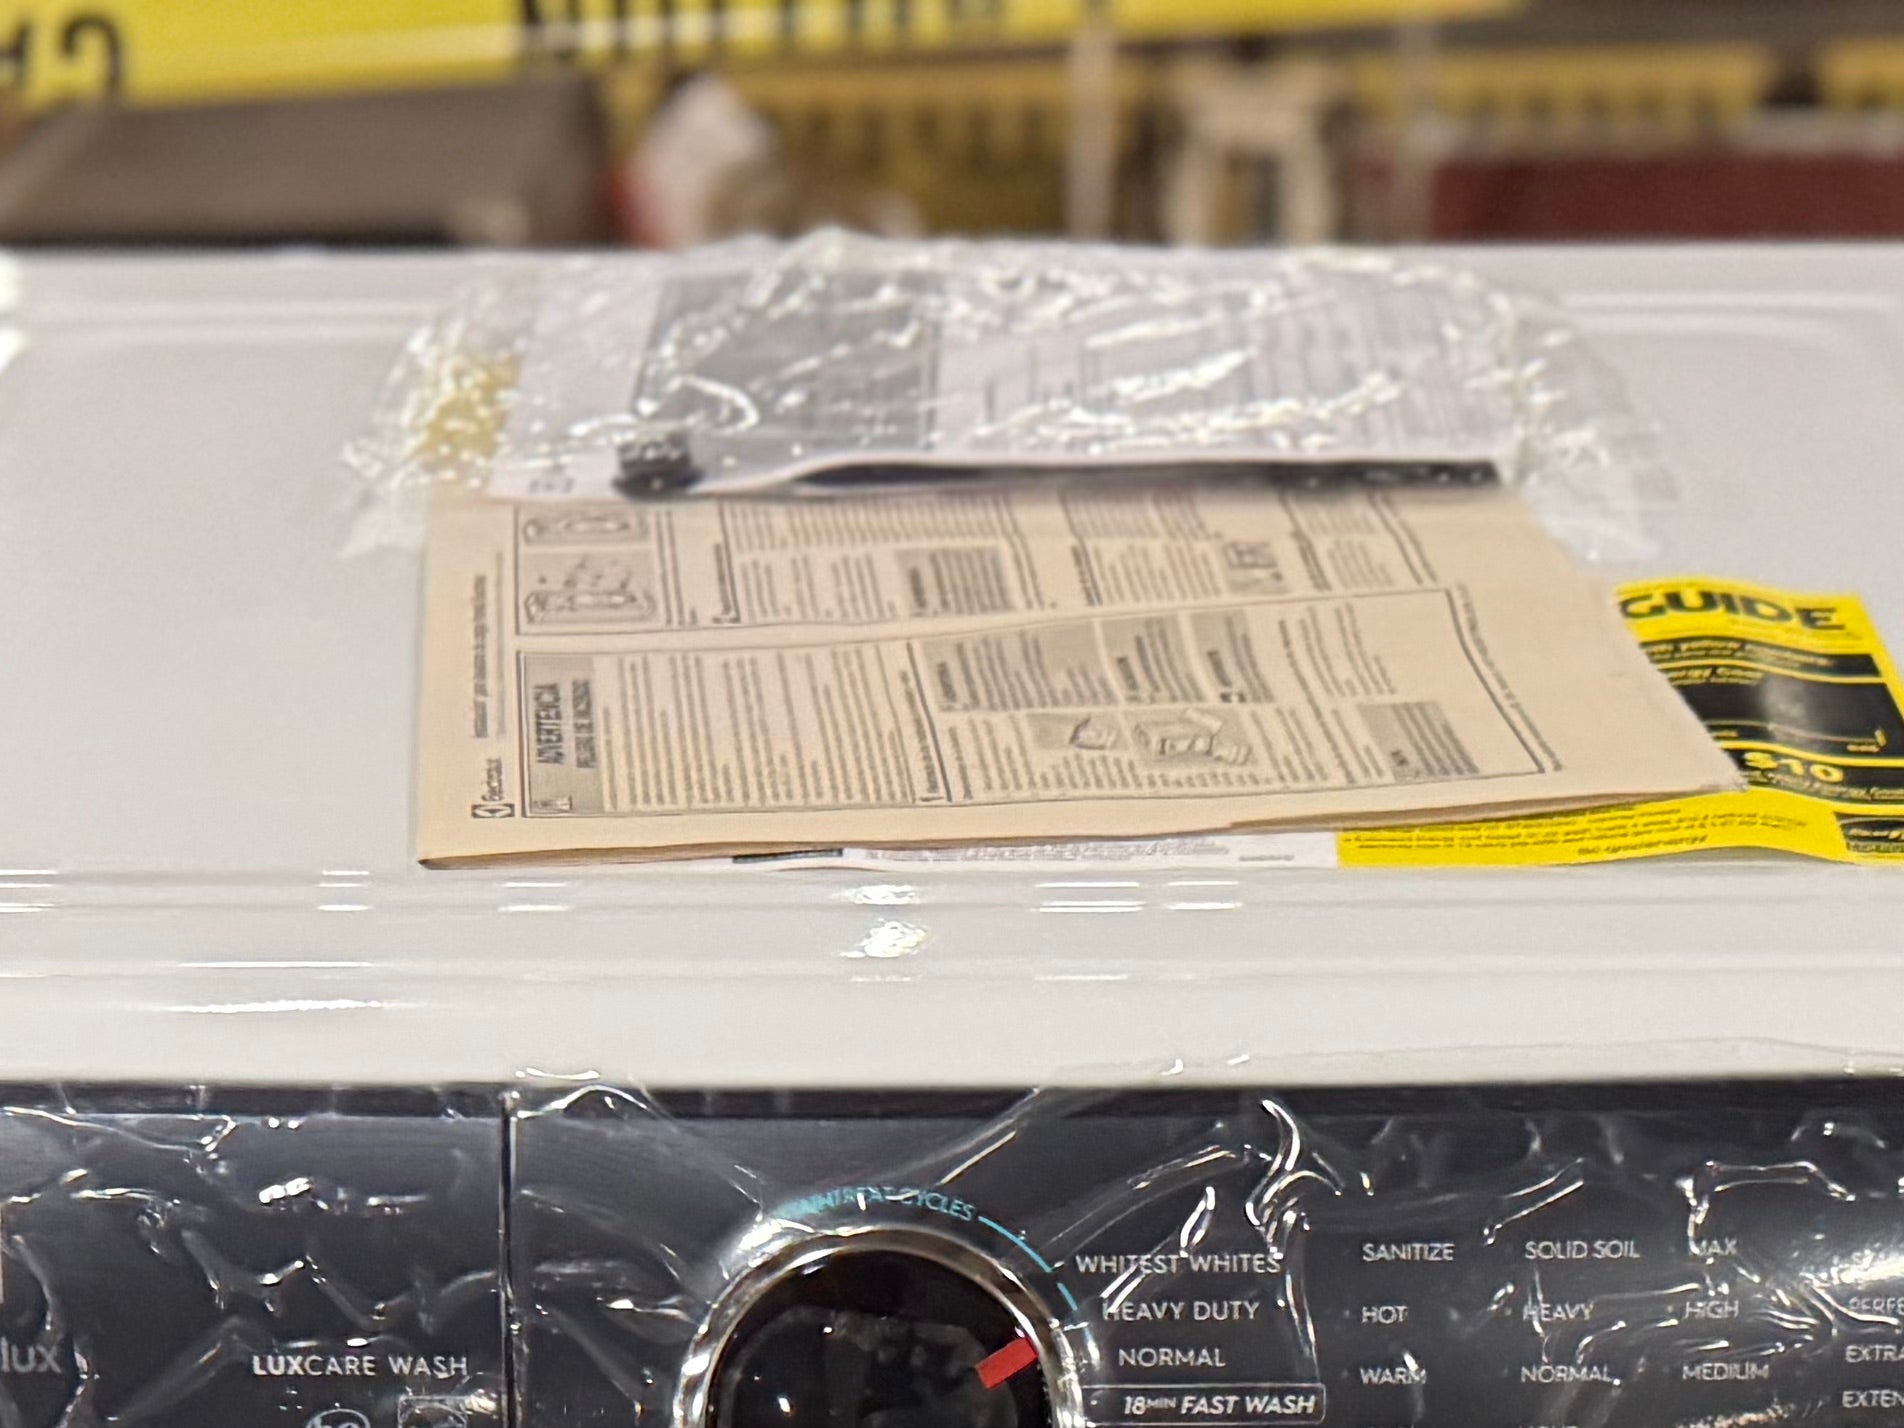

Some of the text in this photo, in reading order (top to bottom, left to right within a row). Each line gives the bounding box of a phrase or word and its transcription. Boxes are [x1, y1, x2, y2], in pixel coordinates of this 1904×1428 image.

[1619, 589, 1846, 631] GUIDE
[1361, 1242, 1456, 1262] SANITIZE
[1524, 1240, 1641, 1259] SOLID SOIL
[1075, 1253, 1282, 1275] WHITEST WHITES
[1102, 1301, 1260, 1322] HEAVY DUTY
[1361, 1305, 1408, 1324] HOT
[1522, 1302, 1594, 1322] HEAVY
[1684, 1299, 1739, 1319] HIGH
[252, 1355, 468, 1378] LUXCARE WASH
[1118, 1348, 1226, 1367] NORMAL
[1359, 1366, 1427, 1385] WARM
[1520, 1365, 1613, 1384] NORMAL
[1682, 1362, 1770, 1381] MEDIUM
[1180, 1396, 1241, 1414] FAST
[1245, 1395, 1316, 1414] WASH
